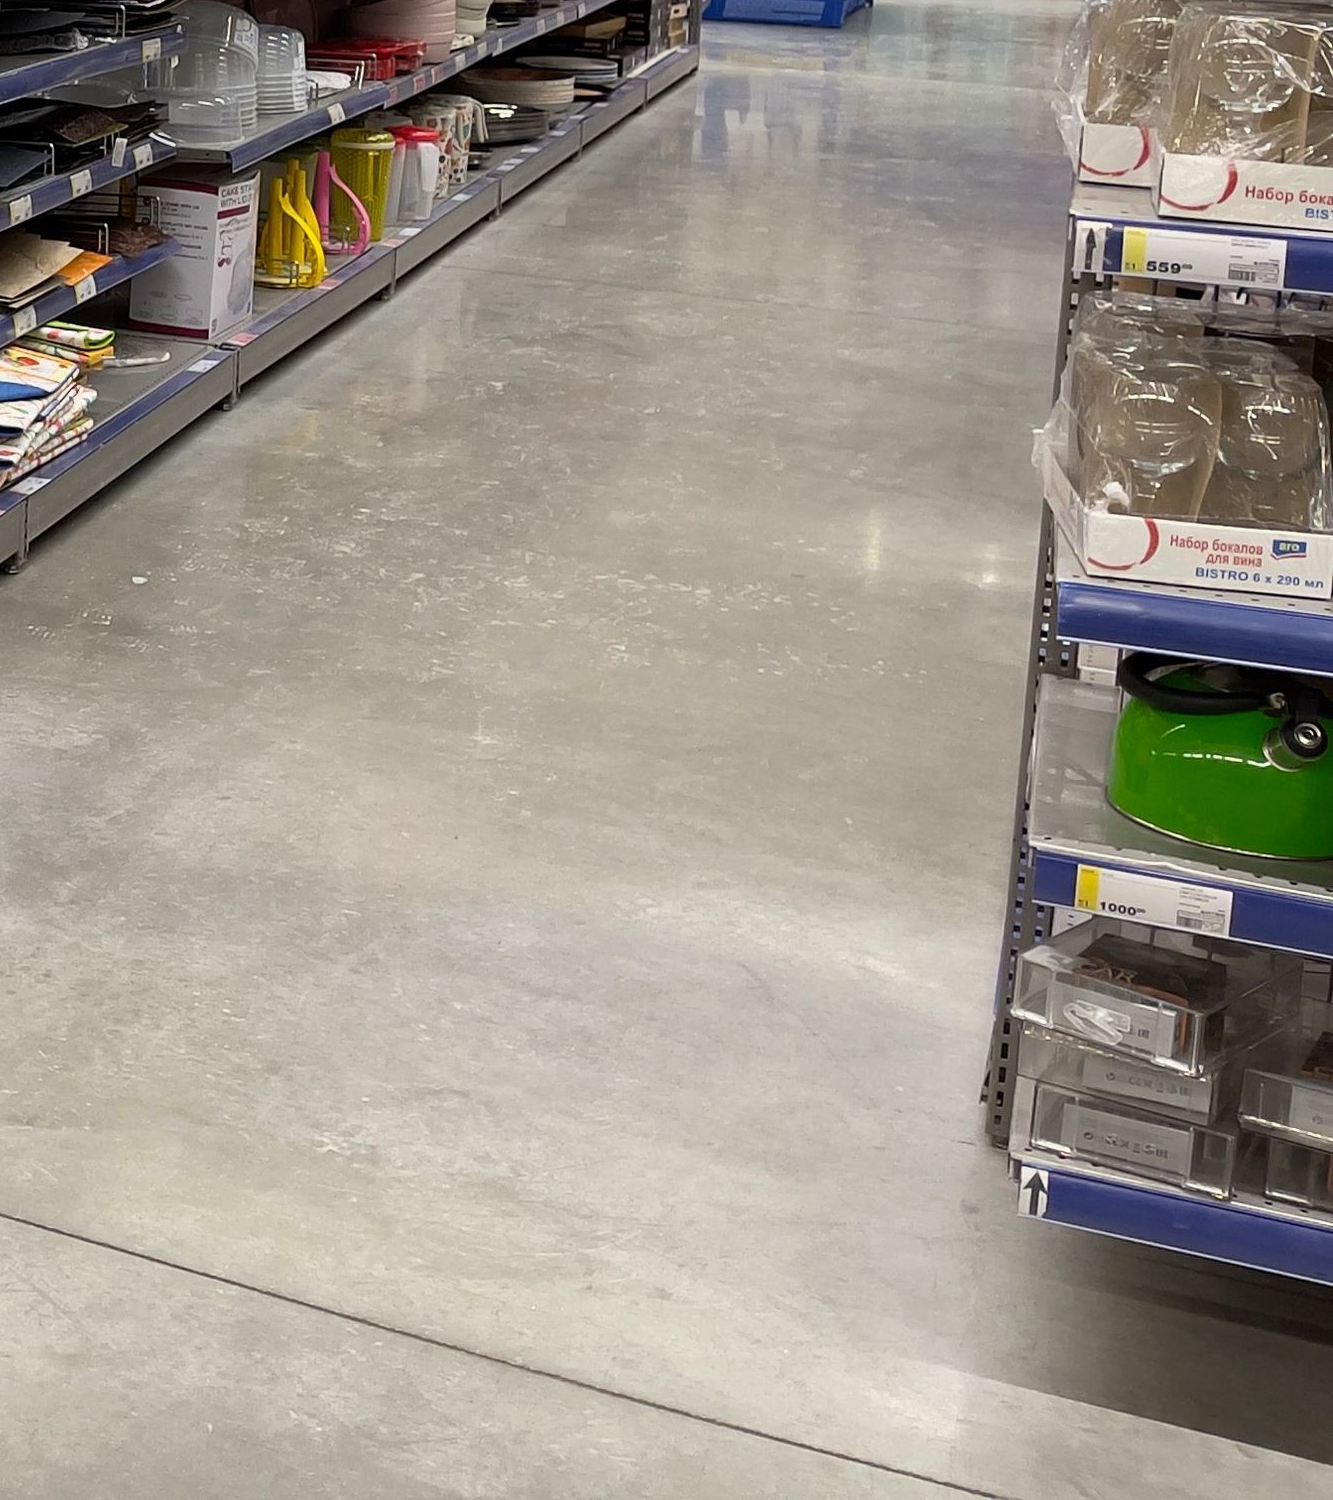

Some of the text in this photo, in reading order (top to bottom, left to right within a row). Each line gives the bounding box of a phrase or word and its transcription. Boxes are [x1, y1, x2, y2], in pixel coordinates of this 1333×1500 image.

[1244, 185, 1333, 206] Набор бока
[1304, 207, 1333, 220] BIS
[1170, 534, 1264, 556] Набор бокалов
[1205, 554, 1263, 568] для вина
[1195, 567, 1249, 582] BISTRO
[1253, 574, 1261, 583] 6
[1277, 575, 1300, 587] 290
[1305, 580, 1324, 589] мл
[1099, 901, 1137, 917] 1000
